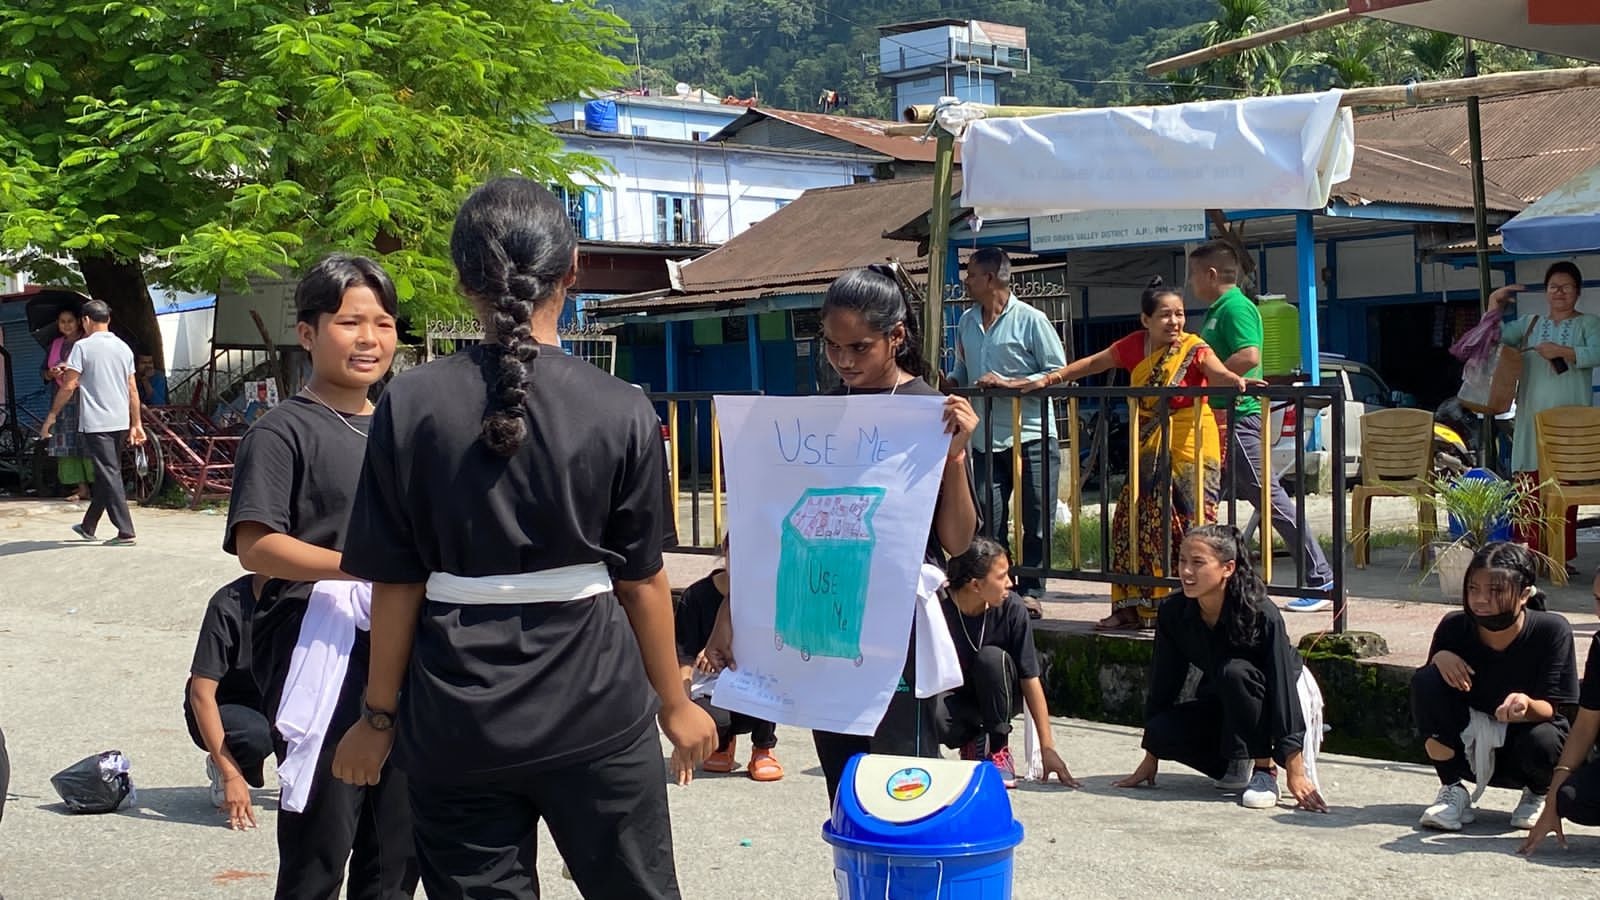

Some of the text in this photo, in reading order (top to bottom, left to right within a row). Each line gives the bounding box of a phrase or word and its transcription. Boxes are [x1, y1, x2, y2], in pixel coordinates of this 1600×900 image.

[1076, 231, 1099, 241] VALLEY
[775, 417, 889, 465] USE ME
[809, 559, 839, 595] USE
